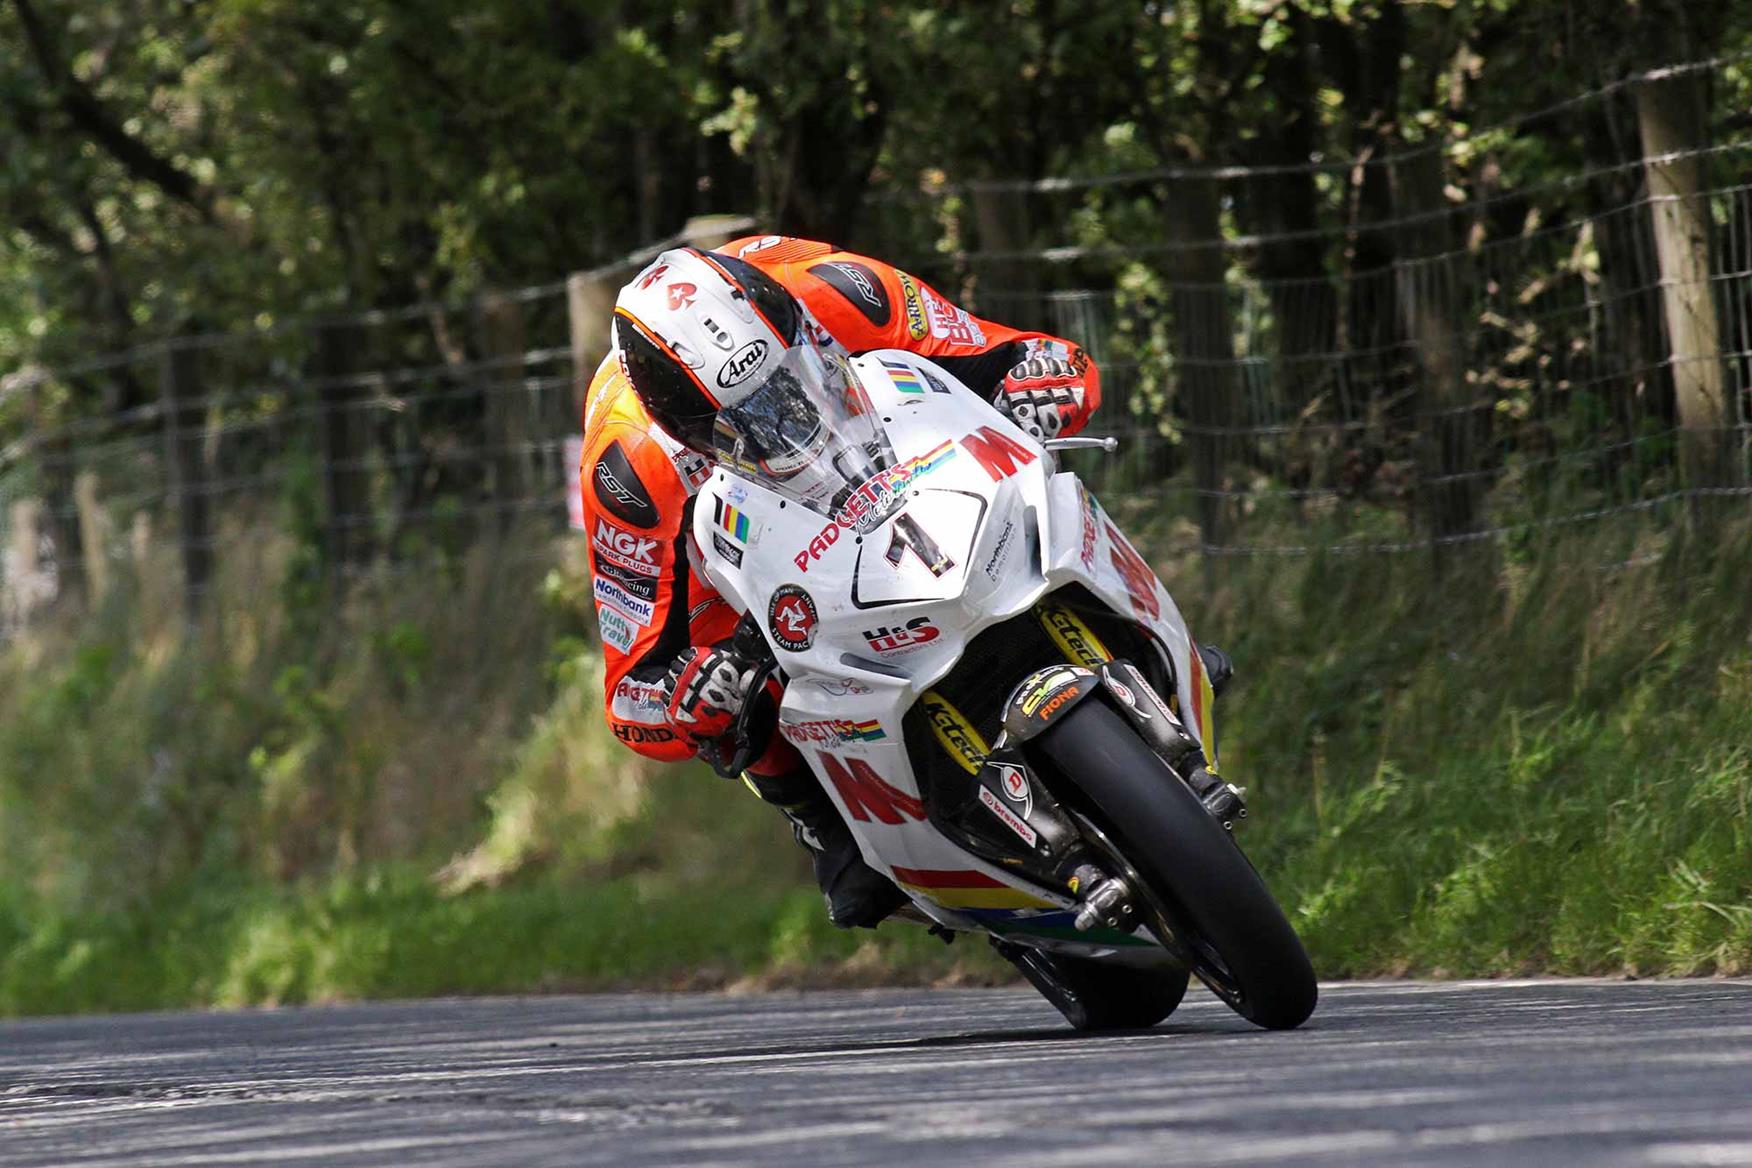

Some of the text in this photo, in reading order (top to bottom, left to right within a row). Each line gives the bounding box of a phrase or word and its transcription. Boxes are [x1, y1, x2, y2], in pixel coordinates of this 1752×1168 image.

[725, 342, 762, 386] Arai
[596, 461, 648, 508] RST
[597, 521, 658, 564] NGK
[622, 559, 653, 574] PLUGS
[595, 578, 651, 617] Northbank
[600, 607, 627, 631] Nutt
[771, 627, 792, 649] STEAM
[1040, 686, 1079, 721] FIONA
[612, 722, 675, 743] HOND
[993, 801, 1033, 841] brembo
